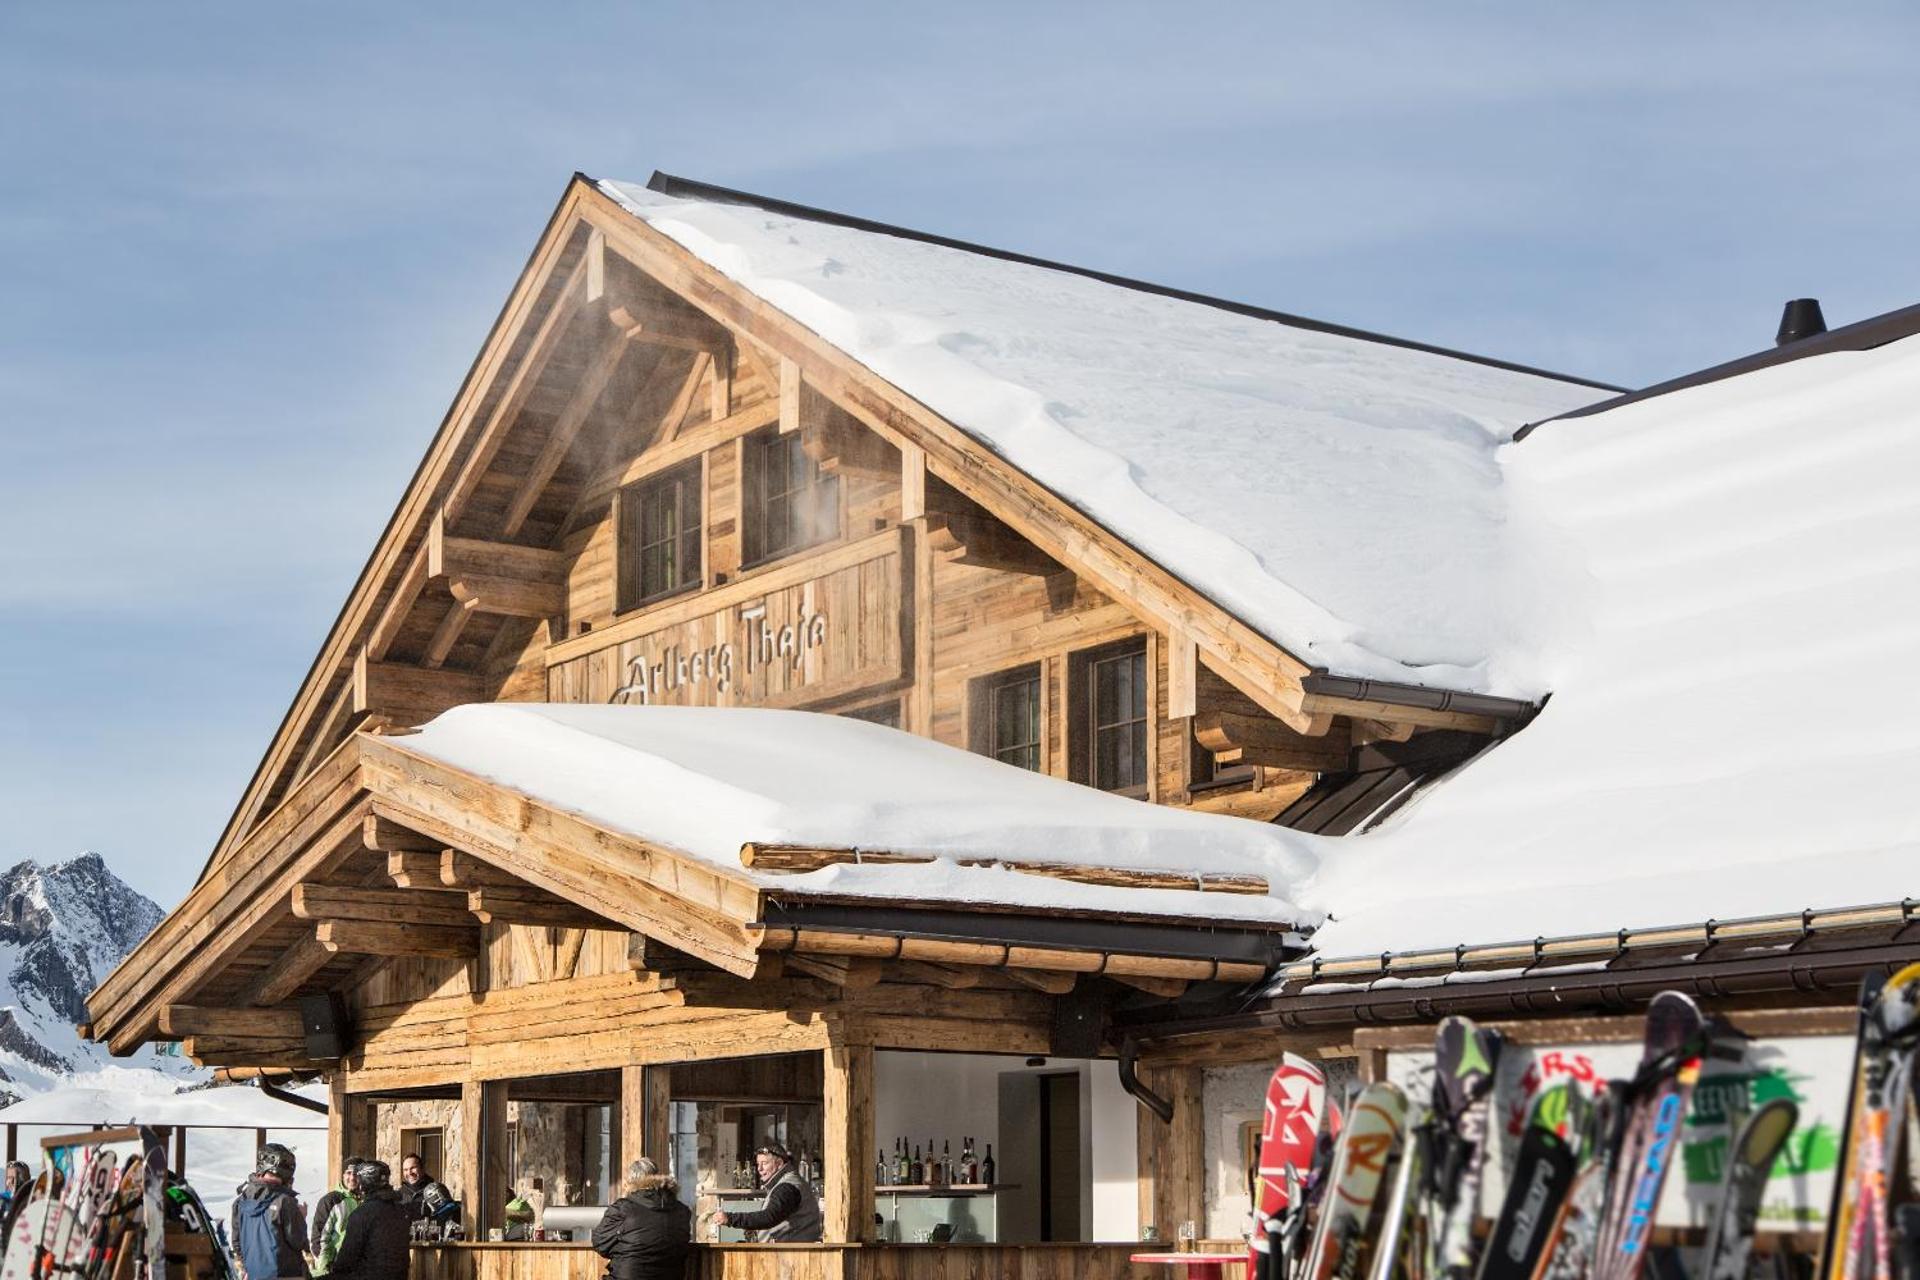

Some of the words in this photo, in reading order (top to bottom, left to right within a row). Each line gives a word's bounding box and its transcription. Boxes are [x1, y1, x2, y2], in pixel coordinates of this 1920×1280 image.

[608, 643, 733, 704] Arlberg
[738, 602, 826, 674] Thaja
[1620, 1093, 1680, 1254] HEAD
